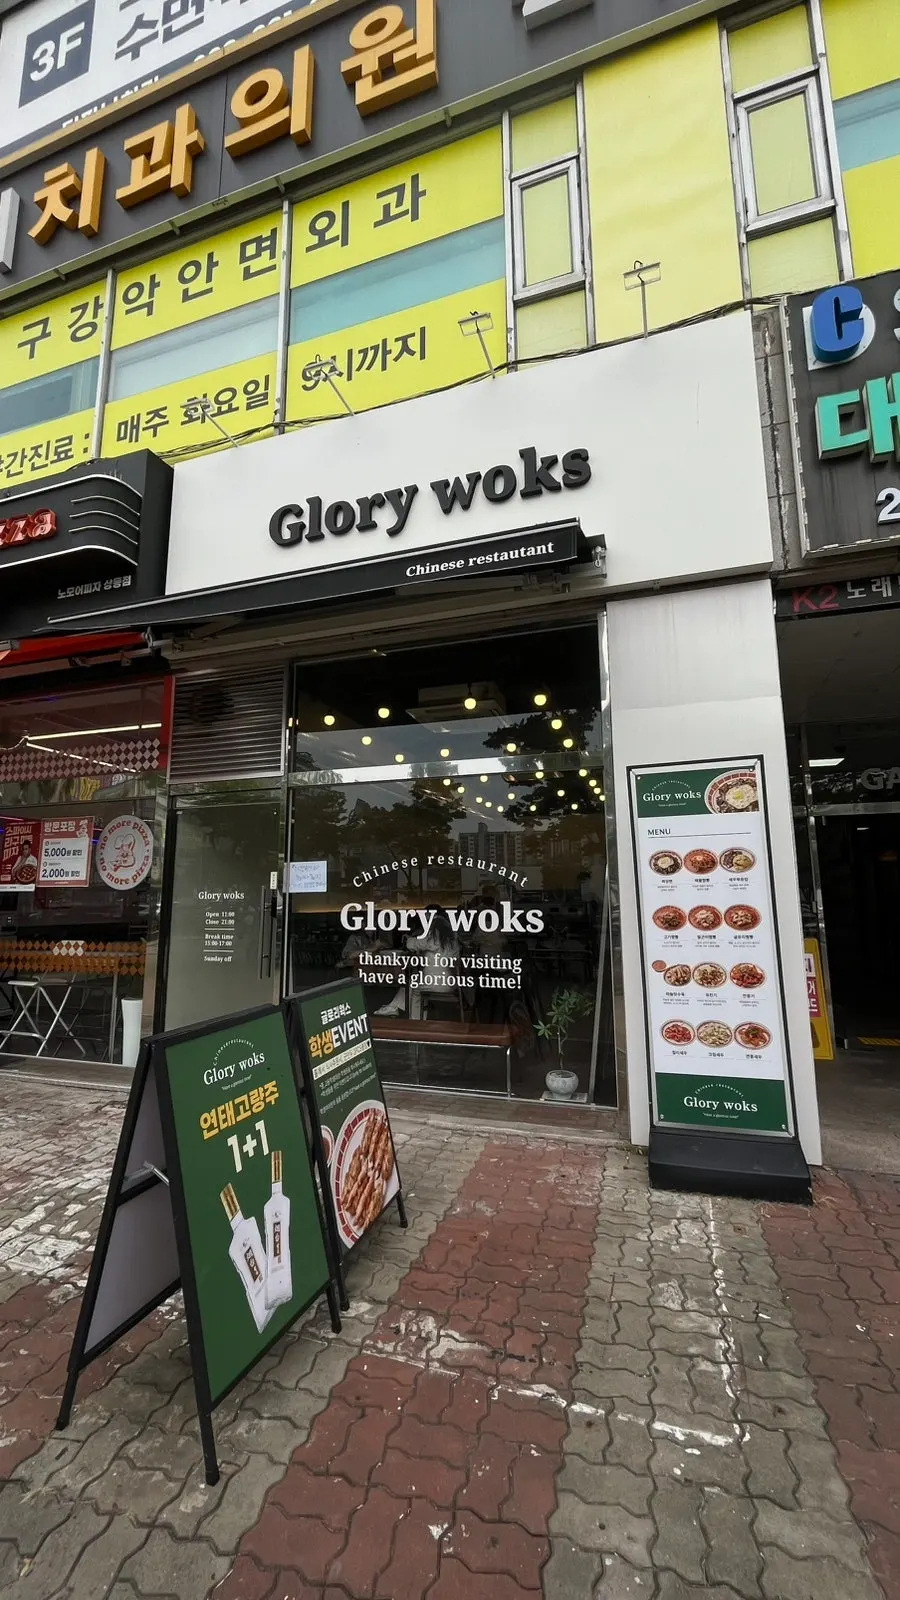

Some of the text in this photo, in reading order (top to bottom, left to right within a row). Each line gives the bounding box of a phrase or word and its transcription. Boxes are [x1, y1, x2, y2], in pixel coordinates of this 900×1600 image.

[29, 21, 86, 82] 3F
[116, 405, 170, 444] 매주
[180, 375, 270, 426] 화요일
[301, 327, 427, 392] 9시까지
[268, 446, 592, 547] Glory woks
[405, 558, 465, 577] Chinese
[56, 580, 102, 600] 노모어피자
[792, 575, 900, 613] K2 노래
[642, 790, 702, 802] Glory woks
[108, 819, 132, 836] more
[132, 821, 150, 847] pizza
[647, 828, 671, 836] MENU
[105, 872, 130, 885] more
[132, 855, 150, 882] pizza
[352, 855, 419, 888] Chinese
[427, 853, 529, 888] restaurant
[198, 890, 245, 902] Glory woks
[340, 901, 545, 940] Glory woks
[359, 951, 523, 974] thankyou for visiting
[359, 969, 522, 990] have a glorious time!
[203, 1063, 236, 1086] Glory
[238, 1052, 265, 1072] woks
[683, 1096, 758, 1112] Glory woks
[226, 1119, 270, 1174] 1+1
